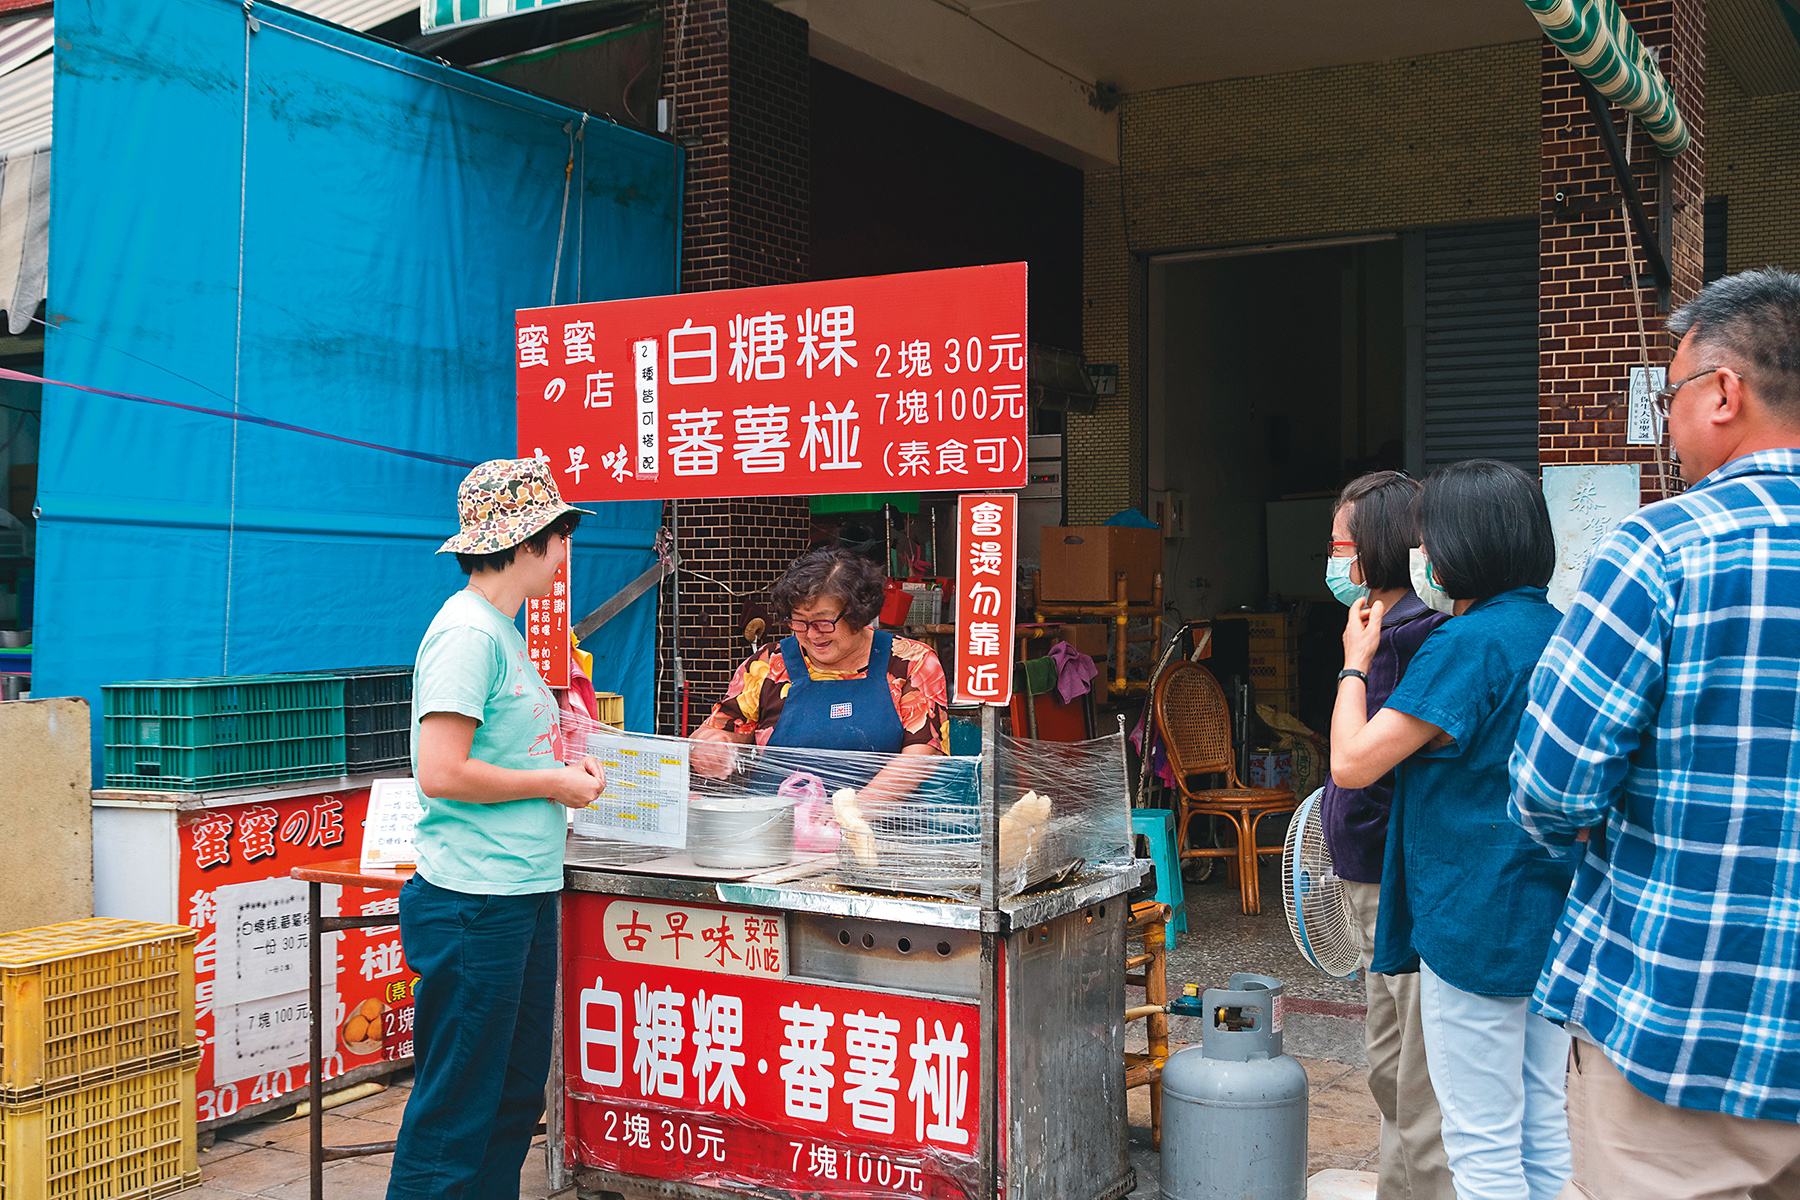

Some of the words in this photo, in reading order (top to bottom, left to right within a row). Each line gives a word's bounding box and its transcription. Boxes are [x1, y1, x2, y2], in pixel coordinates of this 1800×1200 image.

[517, 320, 596, 369] 蜜蜜
[667, 305, 858, 385] 白糖粿
[875, 339, 932, 379] 2塊
[944, 332, 1024, 375] 30元
[543, 370, 614, 410] の店
[641, 344, 655, 471] 2種皆可搭配
[875, 384, 1024, 425] 7塊100元
[667, 400, 863, 477] 蕃薯椪
[882, 435, 1025, 477] (素食可)
[967, 501, 1003, 697] 會燙勿靠近
[191, 796, 345, 869] 蜜蜜の店
[253, 938, 276, 954] 一份
[616, 910, 743, 968] 古早味
[744, 916, 779, 945] 安平
[745, 946, 780, 973] 小吃
[196, 1083, 239, 1120] 30
[604, 1110, 651, 1149] 2塊
[661, 1119, 726, 1162] 30元
[789, 1142, 923, 1193] 7塊100元
